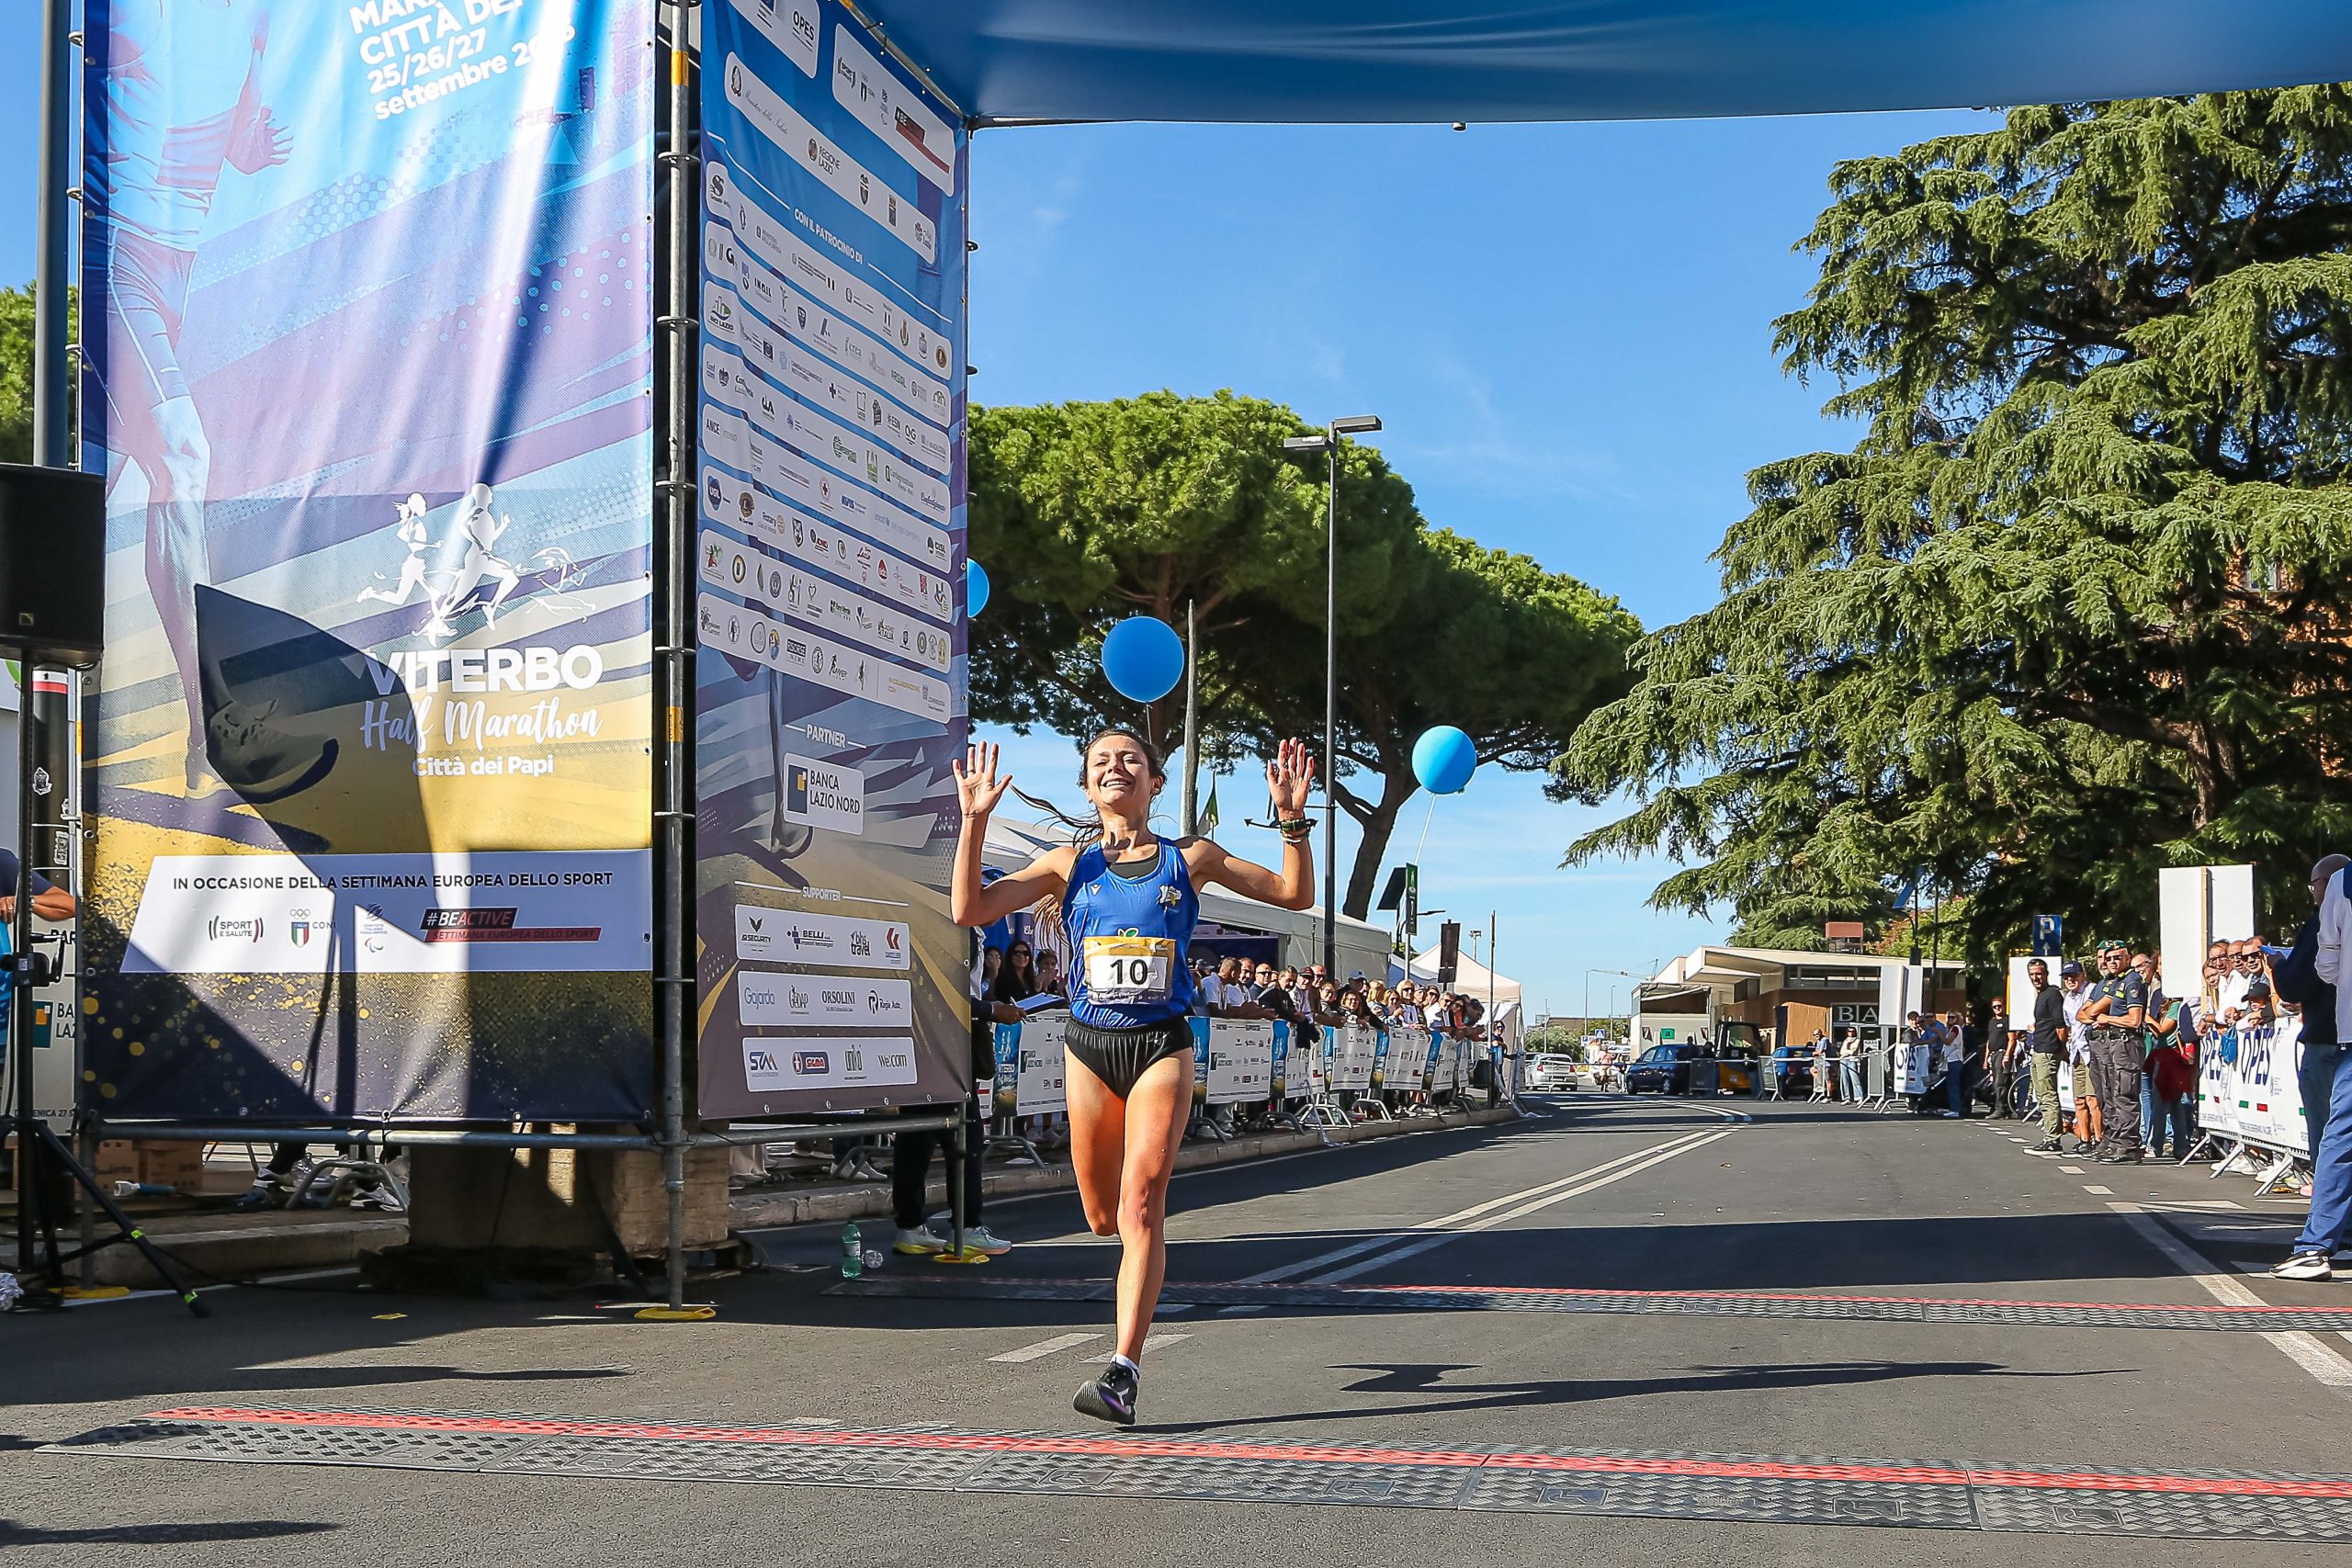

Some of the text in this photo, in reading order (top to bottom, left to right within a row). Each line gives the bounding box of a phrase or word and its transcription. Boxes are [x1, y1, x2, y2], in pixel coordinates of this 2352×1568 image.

[359, 0, 522, 65] CITTÀ DE
[793, 10, 815, 41] OPES
[368, 27, 486, 94] 25/26/27
[374, 54, 507, 120] settembre
[818, 157, 834, 175] LAZIO
[794, 208, 864, 265] CON IL PATROCINIO DI
[368, 645, 604, 695] VITERBO
[360, 696, 604, 754] Half Marathon
[806, 724, 846, 749] PARTNER
[413, 754, 554, 777] Città dei Papi
[810, 770, 840, 791] BANCA
[809, 790, 861, 814] LAZIO NORD
[174, 872, 613, 890] IN OCCASIONE DELLA SETTIMANA EUROPEA DELLO SPORT
[802, 886, 842, 903] SUPPORTER
[220, 921, 252, 930] SPORT
[312, 921, 336, 930] CONI
[426, 910, 514, 927] #BEACTIVE
[2040, 918, 2055, 940] P
[434, 929, 594, 940] SETTIMANA EUROPEA DELLO SPORT
[803, 930, 824, 939] BELLI
[1110, 959, 1148, 985] 10
[744, 987, 775, 1010] Gajarda
[822, 990, 855, 1004] ORSOLINI
[57, 1003, 75, 1019] BA
[1838, 1006, 1879, 1021] BA
[2242, 1027, 2274, 1086] OPES
